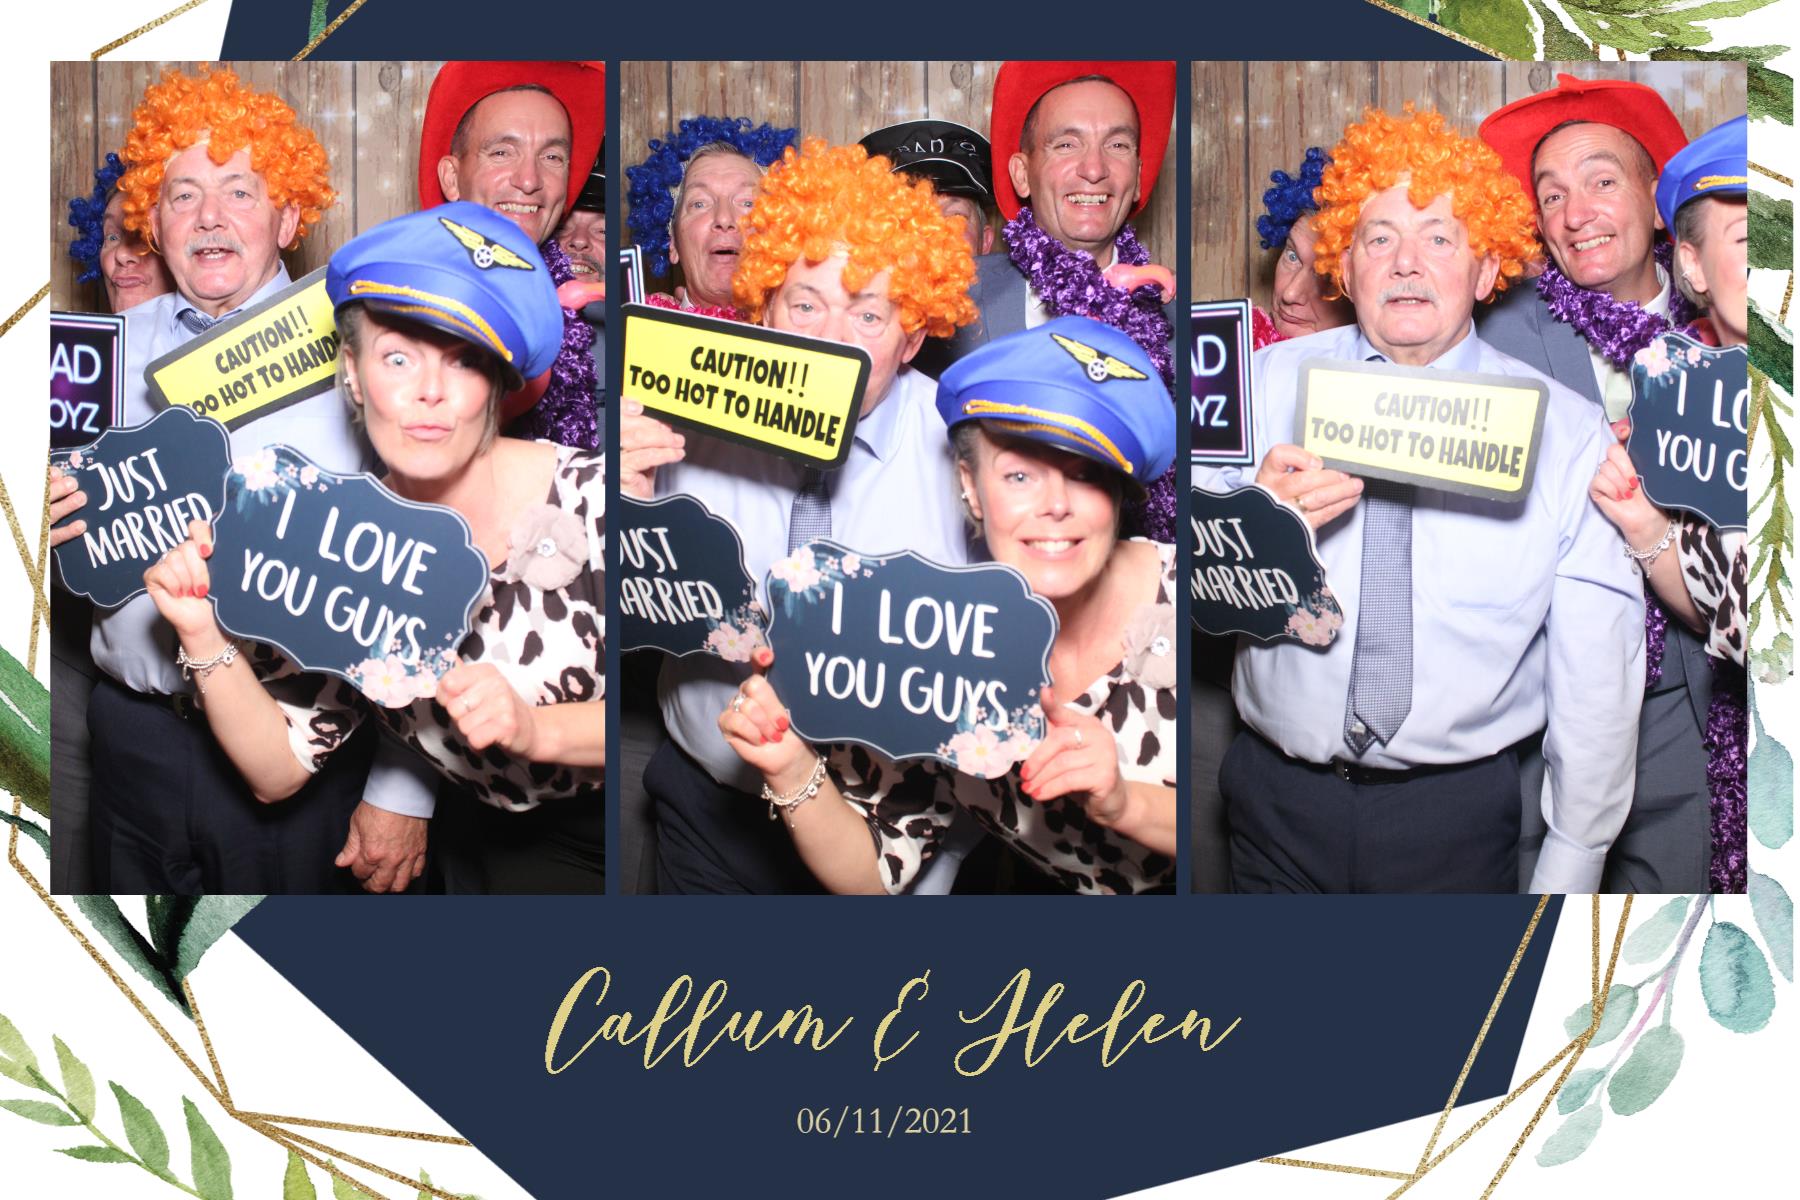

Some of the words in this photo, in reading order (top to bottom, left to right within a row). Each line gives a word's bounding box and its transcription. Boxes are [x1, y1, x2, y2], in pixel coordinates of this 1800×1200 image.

[215, 305, 313, 374] CAUTION!!
[187, 394, 219, 416] OO
[218, 373, 257, 407] HOT
[256, 363, 284, 389] TO
[691, 346, 809, 398] CAUTION!!
[1677, 370, 1687, 416] I
[629, 365, 670, 395] TOO
[674, 377, 719, 410] HOT
[723, 388, 750, 419] TO
[753, 398, 841, 447] HANDLE
[1191, 394, 1229, 428] YZ
[1374, 391, 1491, 433] CAUTION!!
[1311, 417, 1354, 443] TOO
[1358, 424, 1403, 454] HOT
[1408, 431, 1436, 459] TO
[1438, 436, 1524, 478] HANDLE
[1656, 428, 1717, 482] YOU
[86, 448, 167, 511] JUST
[276, 490, 297, 540] I
[318, 506, 438, 595] LOVE
[1191, 514, 1254, 561] JUST
[242, 548, 318, 616] YOU
[324, 585, 427, 665] GUYS
[620, 577, 724, 625] ARRIED
[1191, 565, 1299, 611] MARRIED
[832, 582, 844, 635] I
[878, 589, 1000, 659] LOVE
[805, 651, 886, 709] YOU
[900, 666, 1009, 732] GUYS
